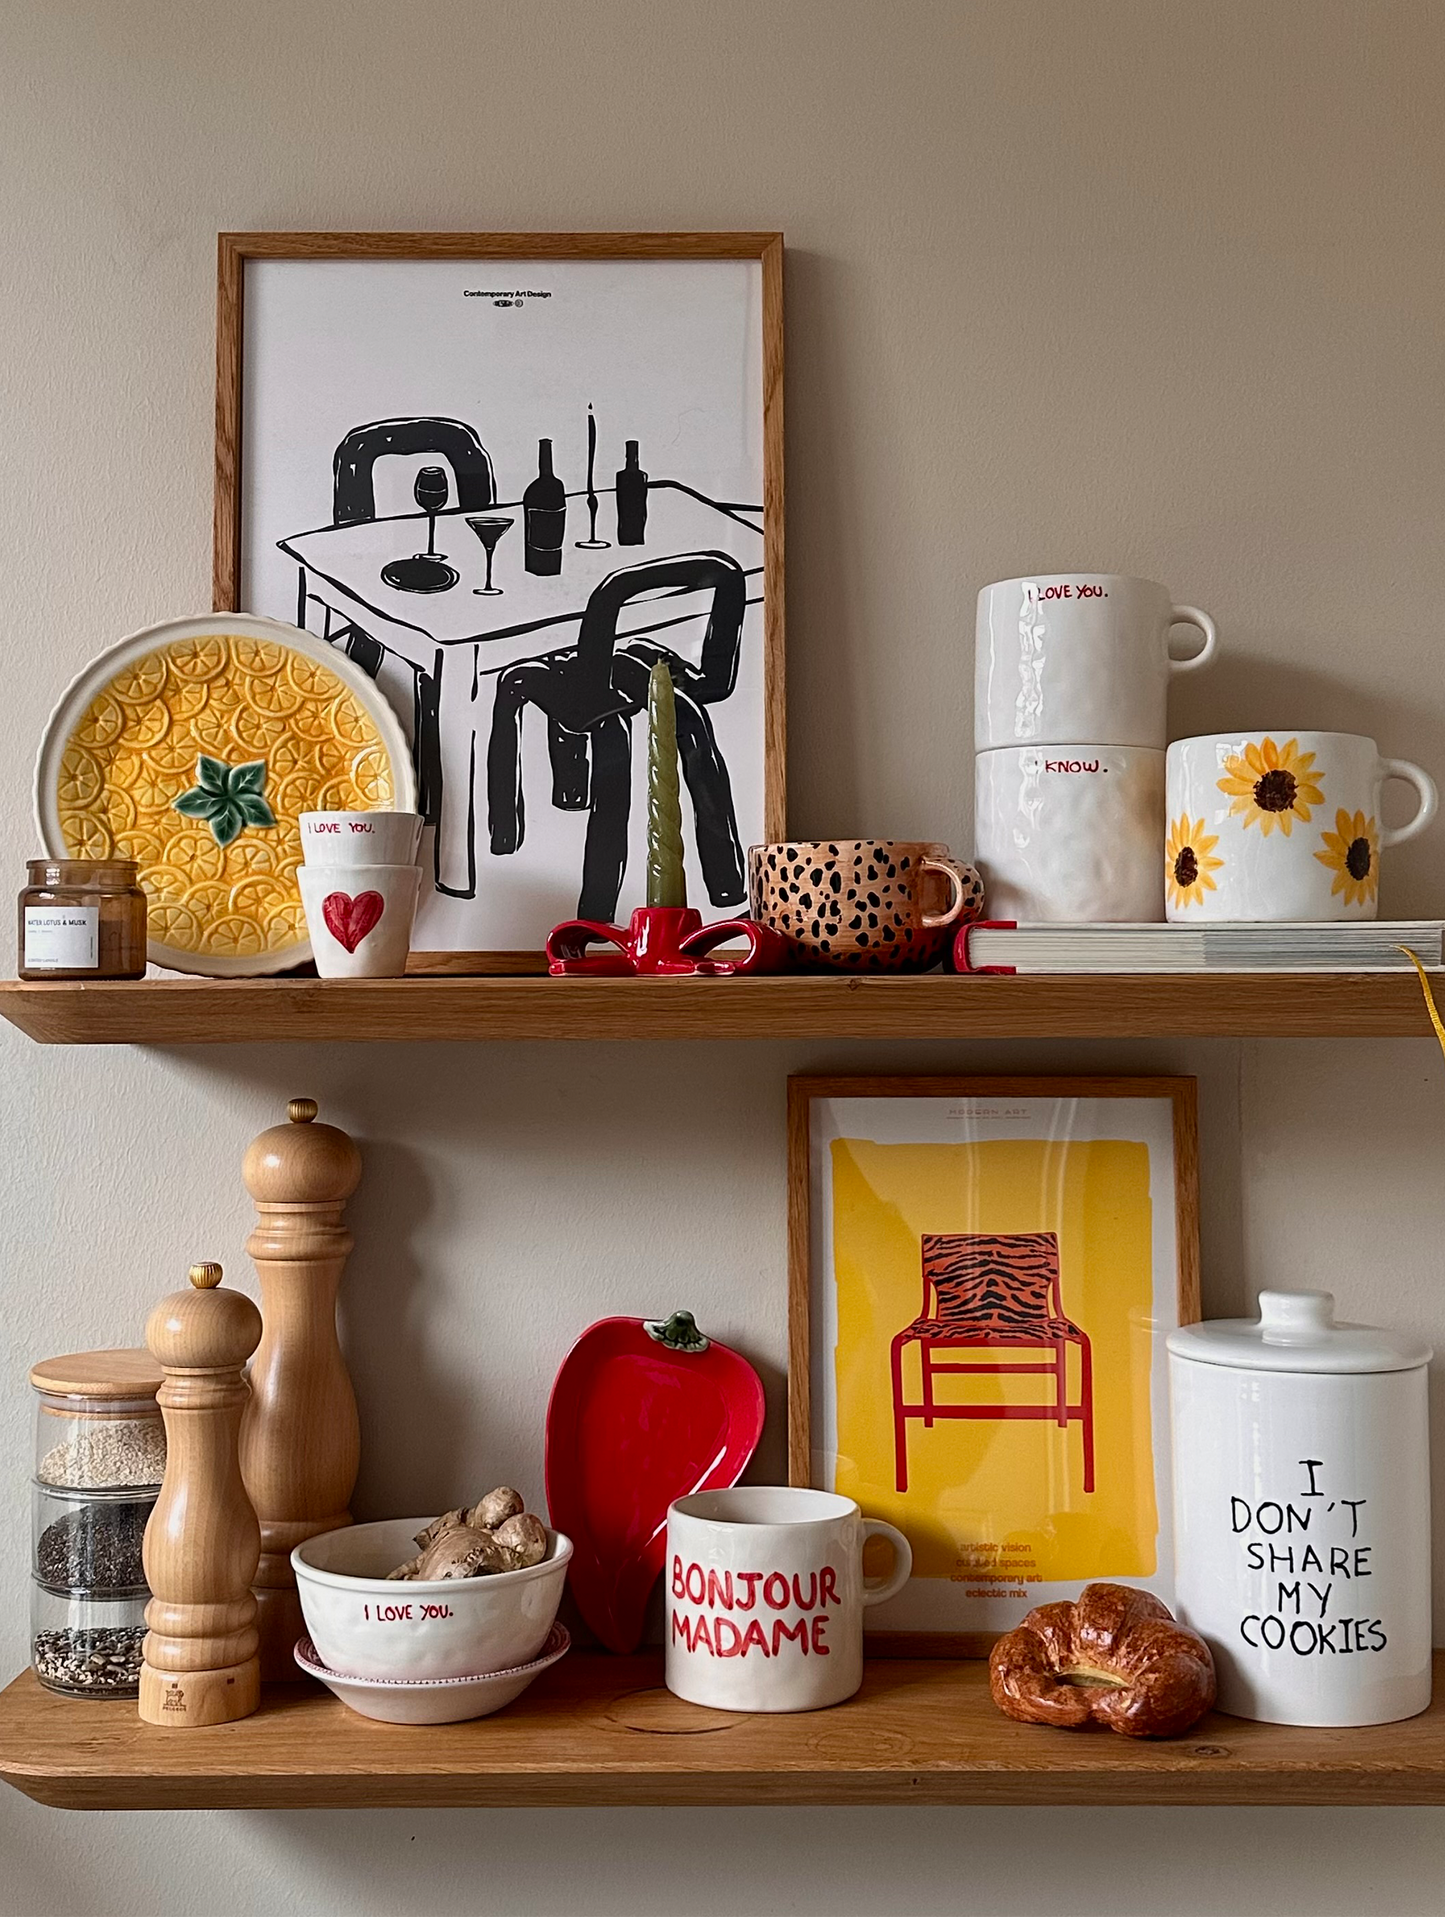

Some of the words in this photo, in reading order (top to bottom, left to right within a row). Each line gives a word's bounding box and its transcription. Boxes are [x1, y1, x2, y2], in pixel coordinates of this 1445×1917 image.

[463, 290, 514, 298] Contemporary
[527, 290, 552, 299] Design
[1028, 588, 1033, 604] I
[1037, 585, 1073, 601] LOVE
[1075, 584, 1109, 600] YOU.
[307, 822, 312, 834] I
[314, 823, 341, 834] LOVE
[348, 822, 376, 834] YOU.
[949, 1108, 999, 1116] MODERN
[1005, 1108, 1028, 1116] ART
[1298, 1459, 1324, 1497] I
[1231, 1496, 1367, 1538] DON'T
[960, 1542, 998, 1552] artistic
[1001, 1542, 1031, 1552] vision
[956, 1557, 997, 1567] cuated
[999, 1559, 1036, 1570] spaces
[1247, 1543, 1372, 1579] SHARE
[672, 1554, 841, 1612] BONJOUR
[951, 1574, 1024, 1585] contemporary
[1026, 1574, 1042, 1583] art
[965, 1588, 1007, 1598] eclectic
[1009, 1588, 1028, 1598] mix
[1278, 1581, 1333, 1618] MY
[364, 1604, 369, 1621] I
[376, 1604, 413, 1621] LOVE
[419, 1604, 454, 1621] YOU.
[672, 1608, 830, 1659] MADAME
[1241, 1614, 1388, 1656] COOKIES
